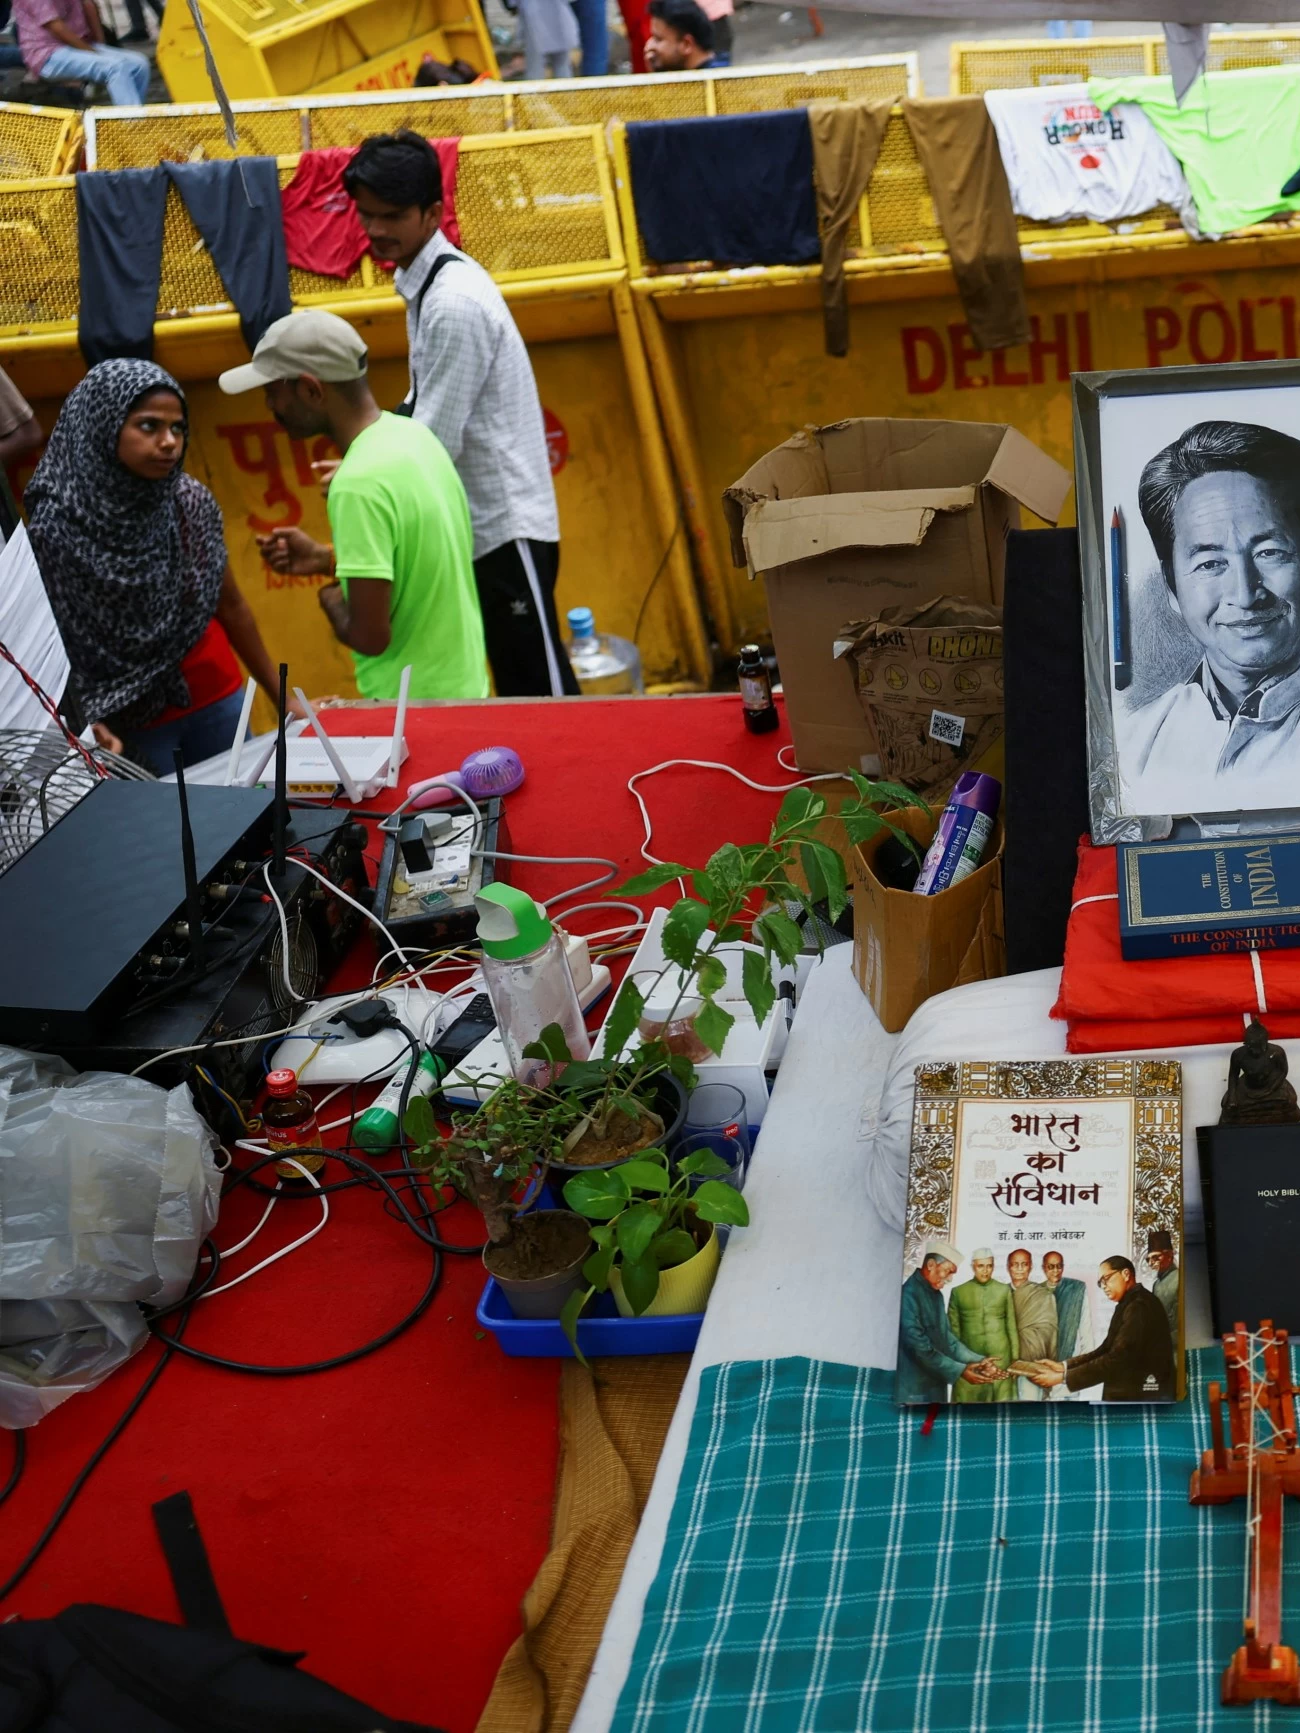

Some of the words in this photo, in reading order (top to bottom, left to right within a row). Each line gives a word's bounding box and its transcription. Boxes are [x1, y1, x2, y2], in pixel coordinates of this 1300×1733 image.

[1201, 873, 1212, 888] THE
[1214, 851, 1232, 909] CONSTITUTION
[1233, 873, 1243, 883] OF
[1246, 846, 1280, 907] INDIA
[1170, 932, 1201, 944] THE
[1211, 942, 1230, 951] OF
[1236, 939, 1277, 950] INDIA
[1011, 1113, 1084, 1152] भारत
[1024, 1151, 1068, 1173] का
[985, 1172, 1104, 1219] संविधान
